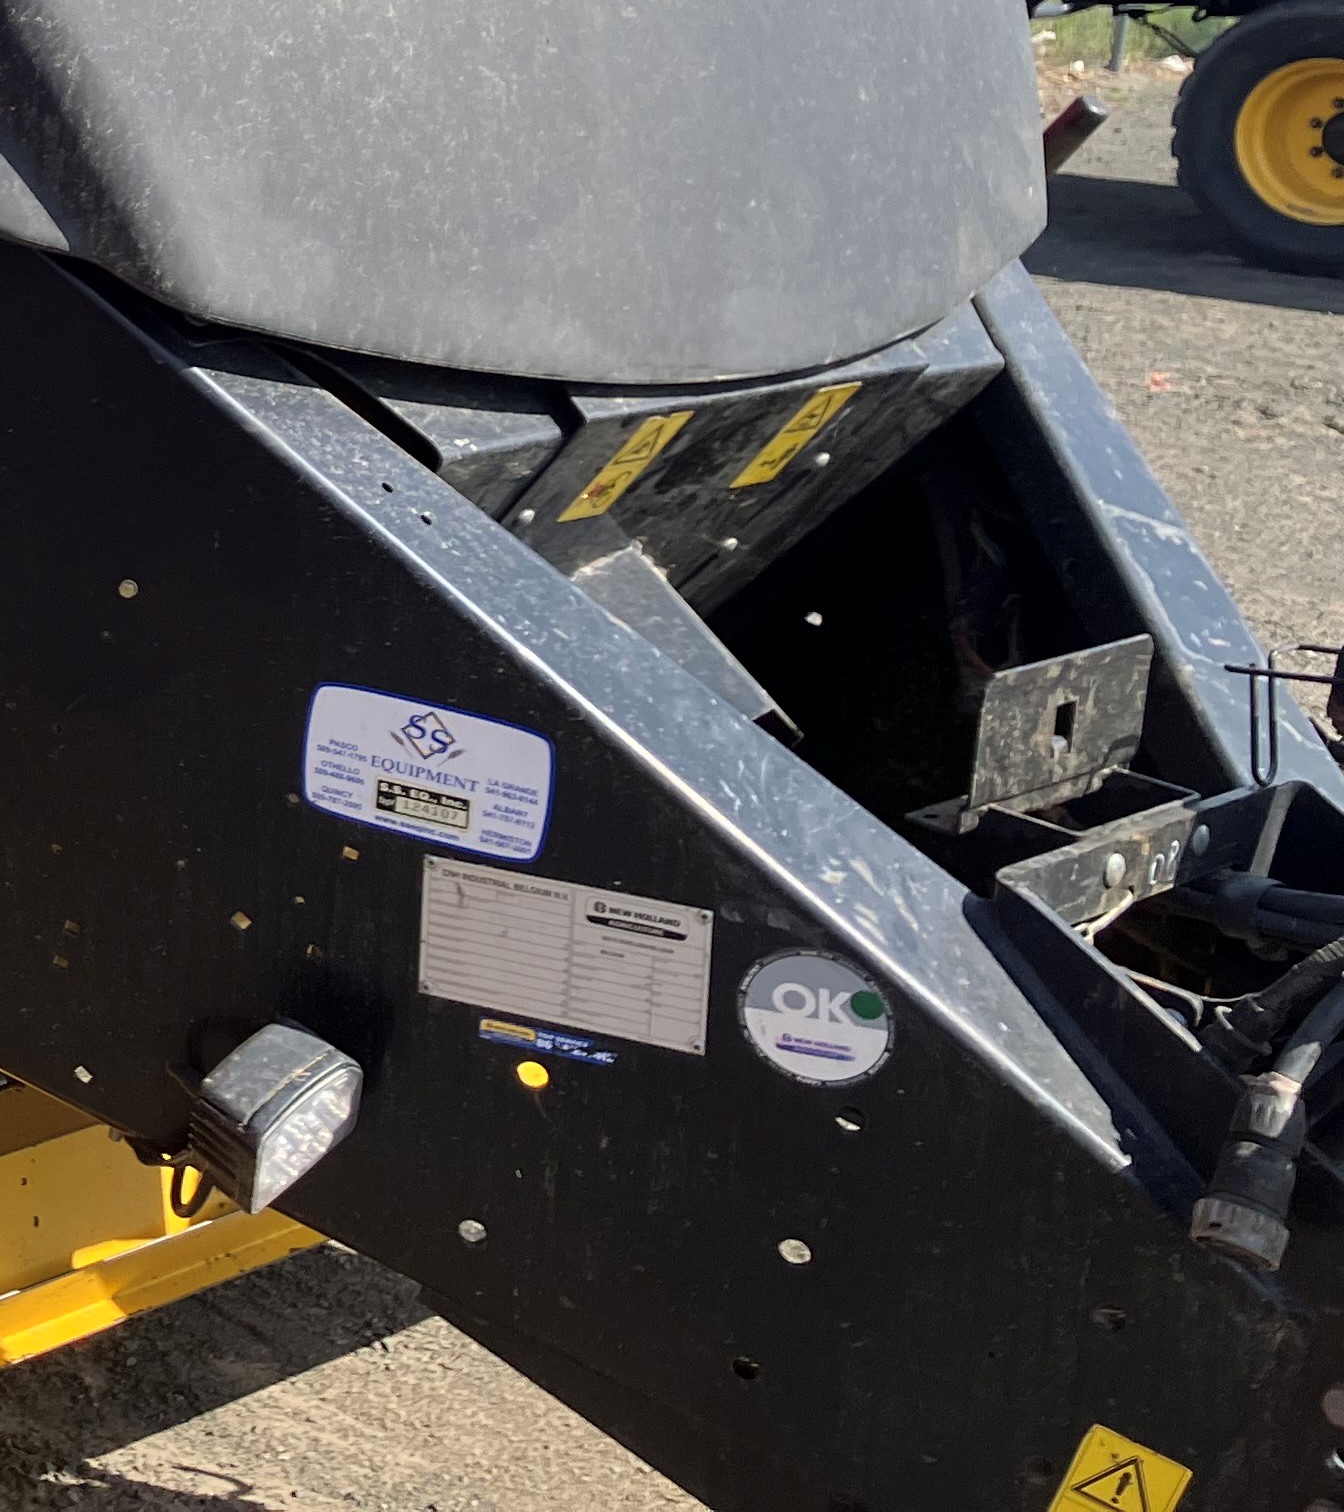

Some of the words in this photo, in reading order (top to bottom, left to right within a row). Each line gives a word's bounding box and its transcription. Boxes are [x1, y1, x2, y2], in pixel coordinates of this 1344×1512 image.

[320, 760, 361, 776] OTHELLO
[370, 754, 481, 793] EQUIPMENT
[634, 911, 682, 928] HOLLAND
[772, 982, 856, 1028] OK
